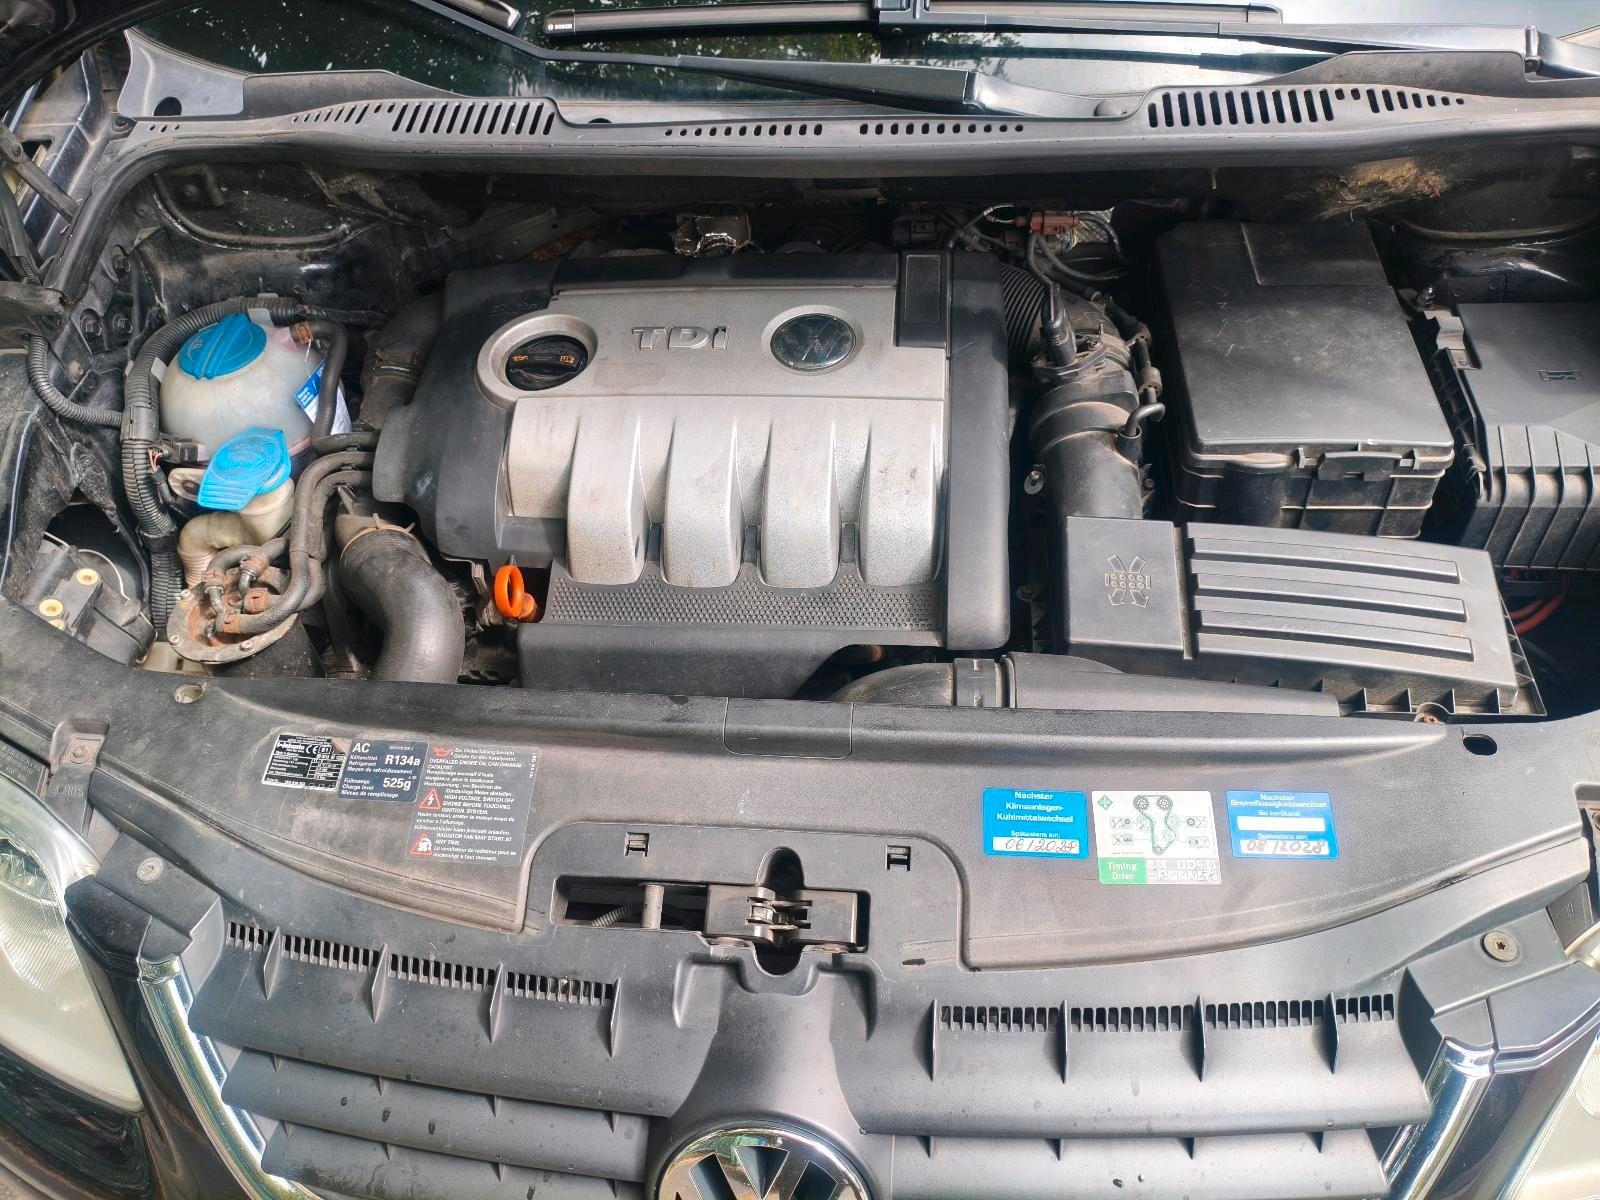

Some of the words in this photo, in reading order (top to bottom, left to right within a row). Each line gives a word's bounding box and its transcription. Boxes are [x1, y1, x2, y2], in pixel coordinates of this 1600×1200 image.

[632, 325, 730, 350] TDI
[352, 743, 371, 753] AC
[384, 754, 420, 766] R134a
[383, 778, 411, 791] 525g
[1107, 862, 1137, 871] Timing
[1111, 871, 1135, 880] Drive
